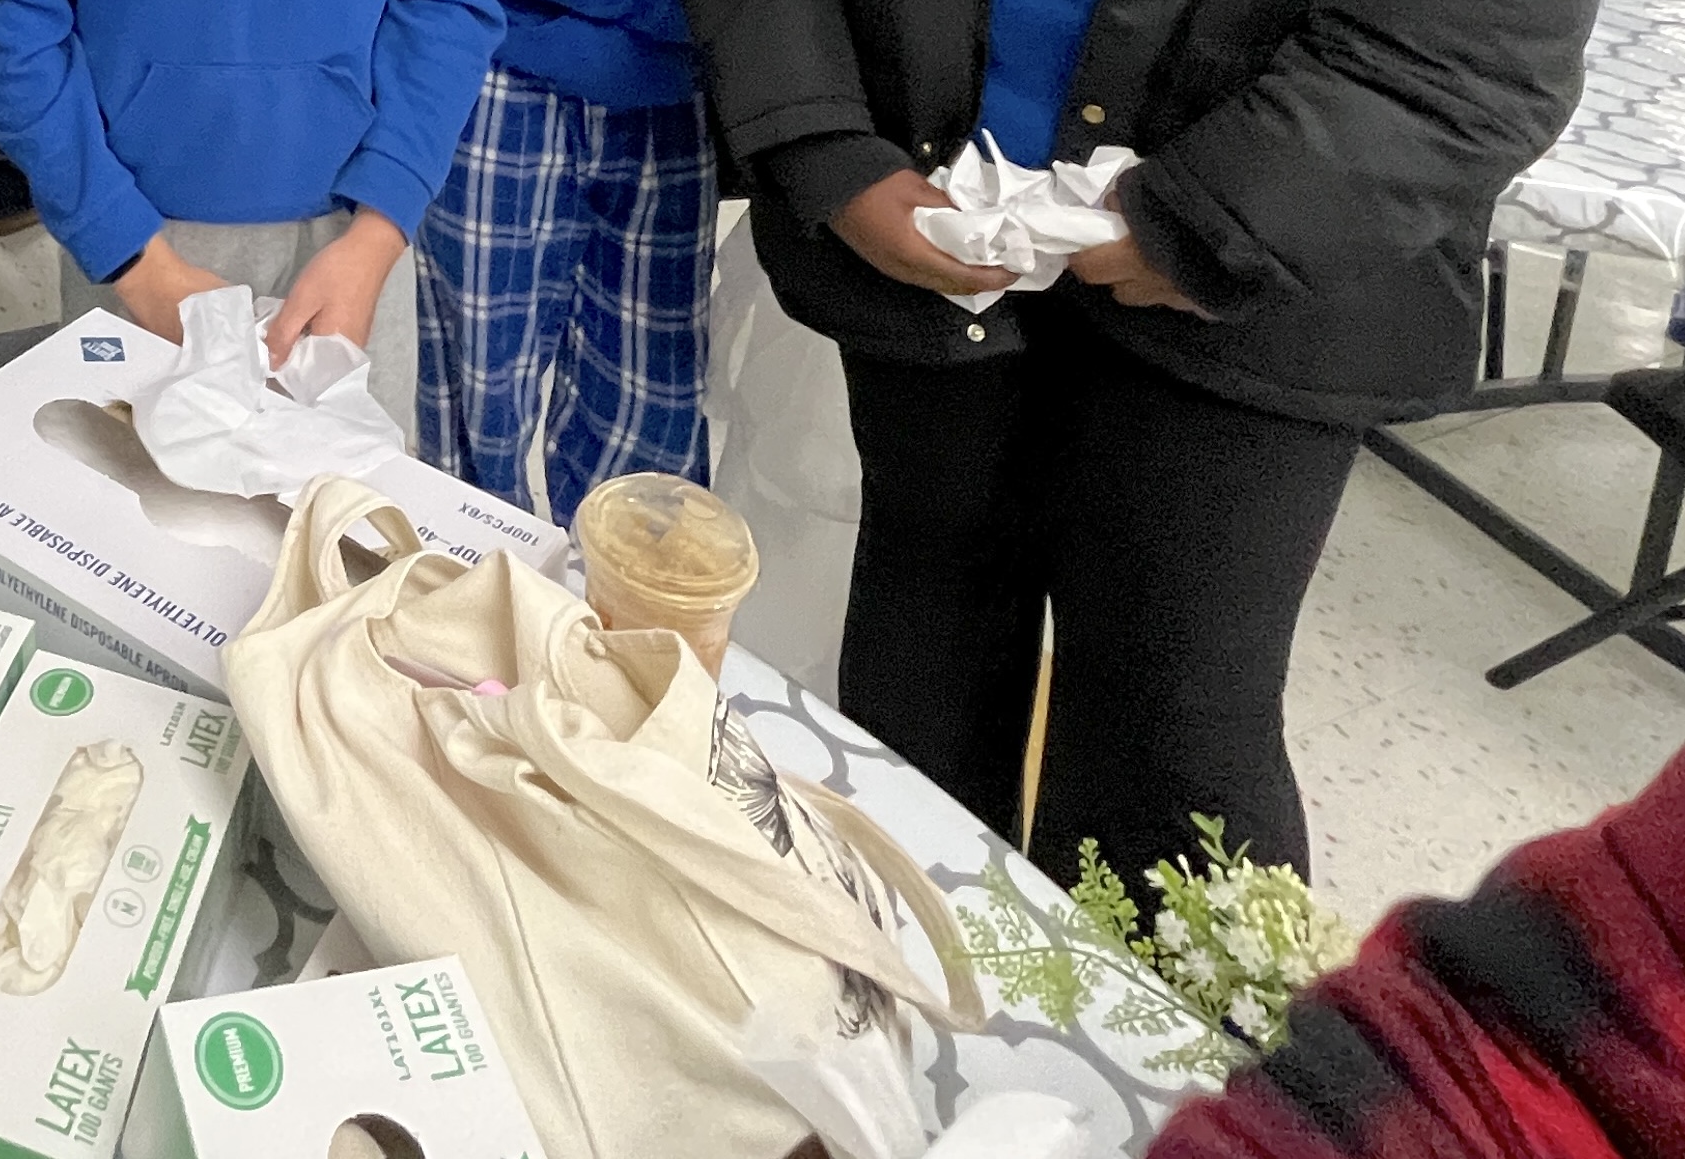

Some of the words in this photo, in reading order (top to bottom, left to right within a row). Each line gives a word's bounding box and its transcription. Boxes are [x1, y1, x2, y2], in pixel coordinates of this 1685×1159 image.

[9, 512, 111, 578] DISPOSABLE
[458, 502, 540, 547] 100PCS/BX
[107, 570, 228, 648] OLYETHYLENE
[70, 611, 142, 670] DISPOSABLE
[145, 658, 190, 694] APRON
[180, 709, 229, 769] LATEX
[394, 977, 466, 1082] LATEX
[433, 971, 475, 1040] GUANTES
[35, 1036, 102, 1137] LATEX
[87, 1052, 124, 1112] GANTS
[223, 1027, 256, 1094] PREMIUM
[463, 1043, 488, 1072] 100
[73, 1108, 104, 1147] 100
